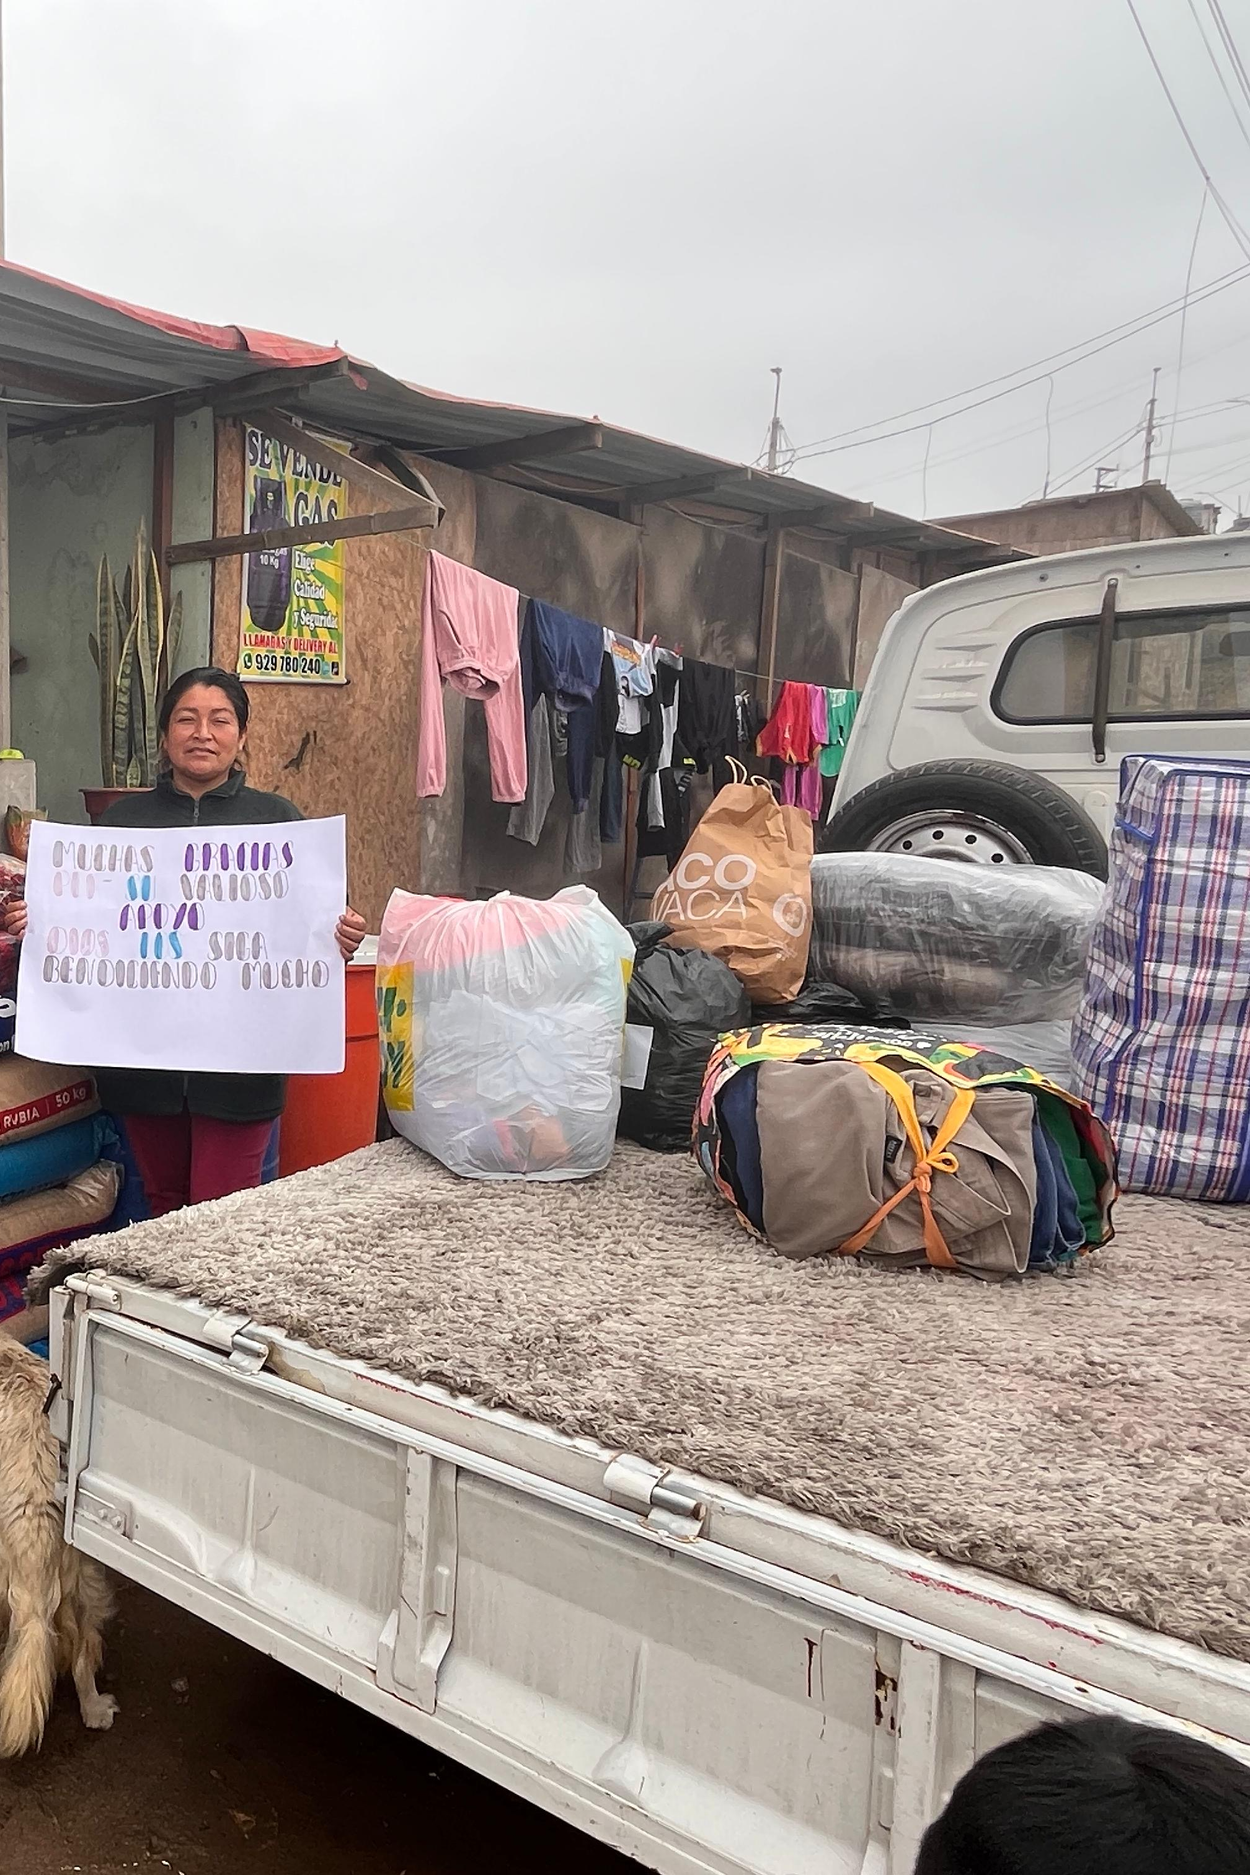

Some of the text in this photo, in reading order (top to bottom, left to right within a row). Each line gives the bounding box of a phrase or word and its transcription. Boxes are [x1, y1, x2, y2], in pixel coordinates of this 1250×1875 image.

[295, 550, 315, 575] Elige
[295, 579, 325, 600] Calidad
[294, 638, 326, 653] DELIVERY
[255, 653, 321, 675] 929 780 240
[52, 839, 294, 873] MUCHAS GRACIAS
[180, 870, 289, 901] VALIOSO
[119, 902, 205, 931] APOYO
[47, 926, 110, 958] DIOS
[207, 931, 268, 961] SIGA
[43, 955, 330, 990] BENDICIENDO MUCHO
[3, 1106, 41, 1129] RUBIA
[55, 1091, 71, 1107] 50
[72, 1086, 87, 1101] kg
